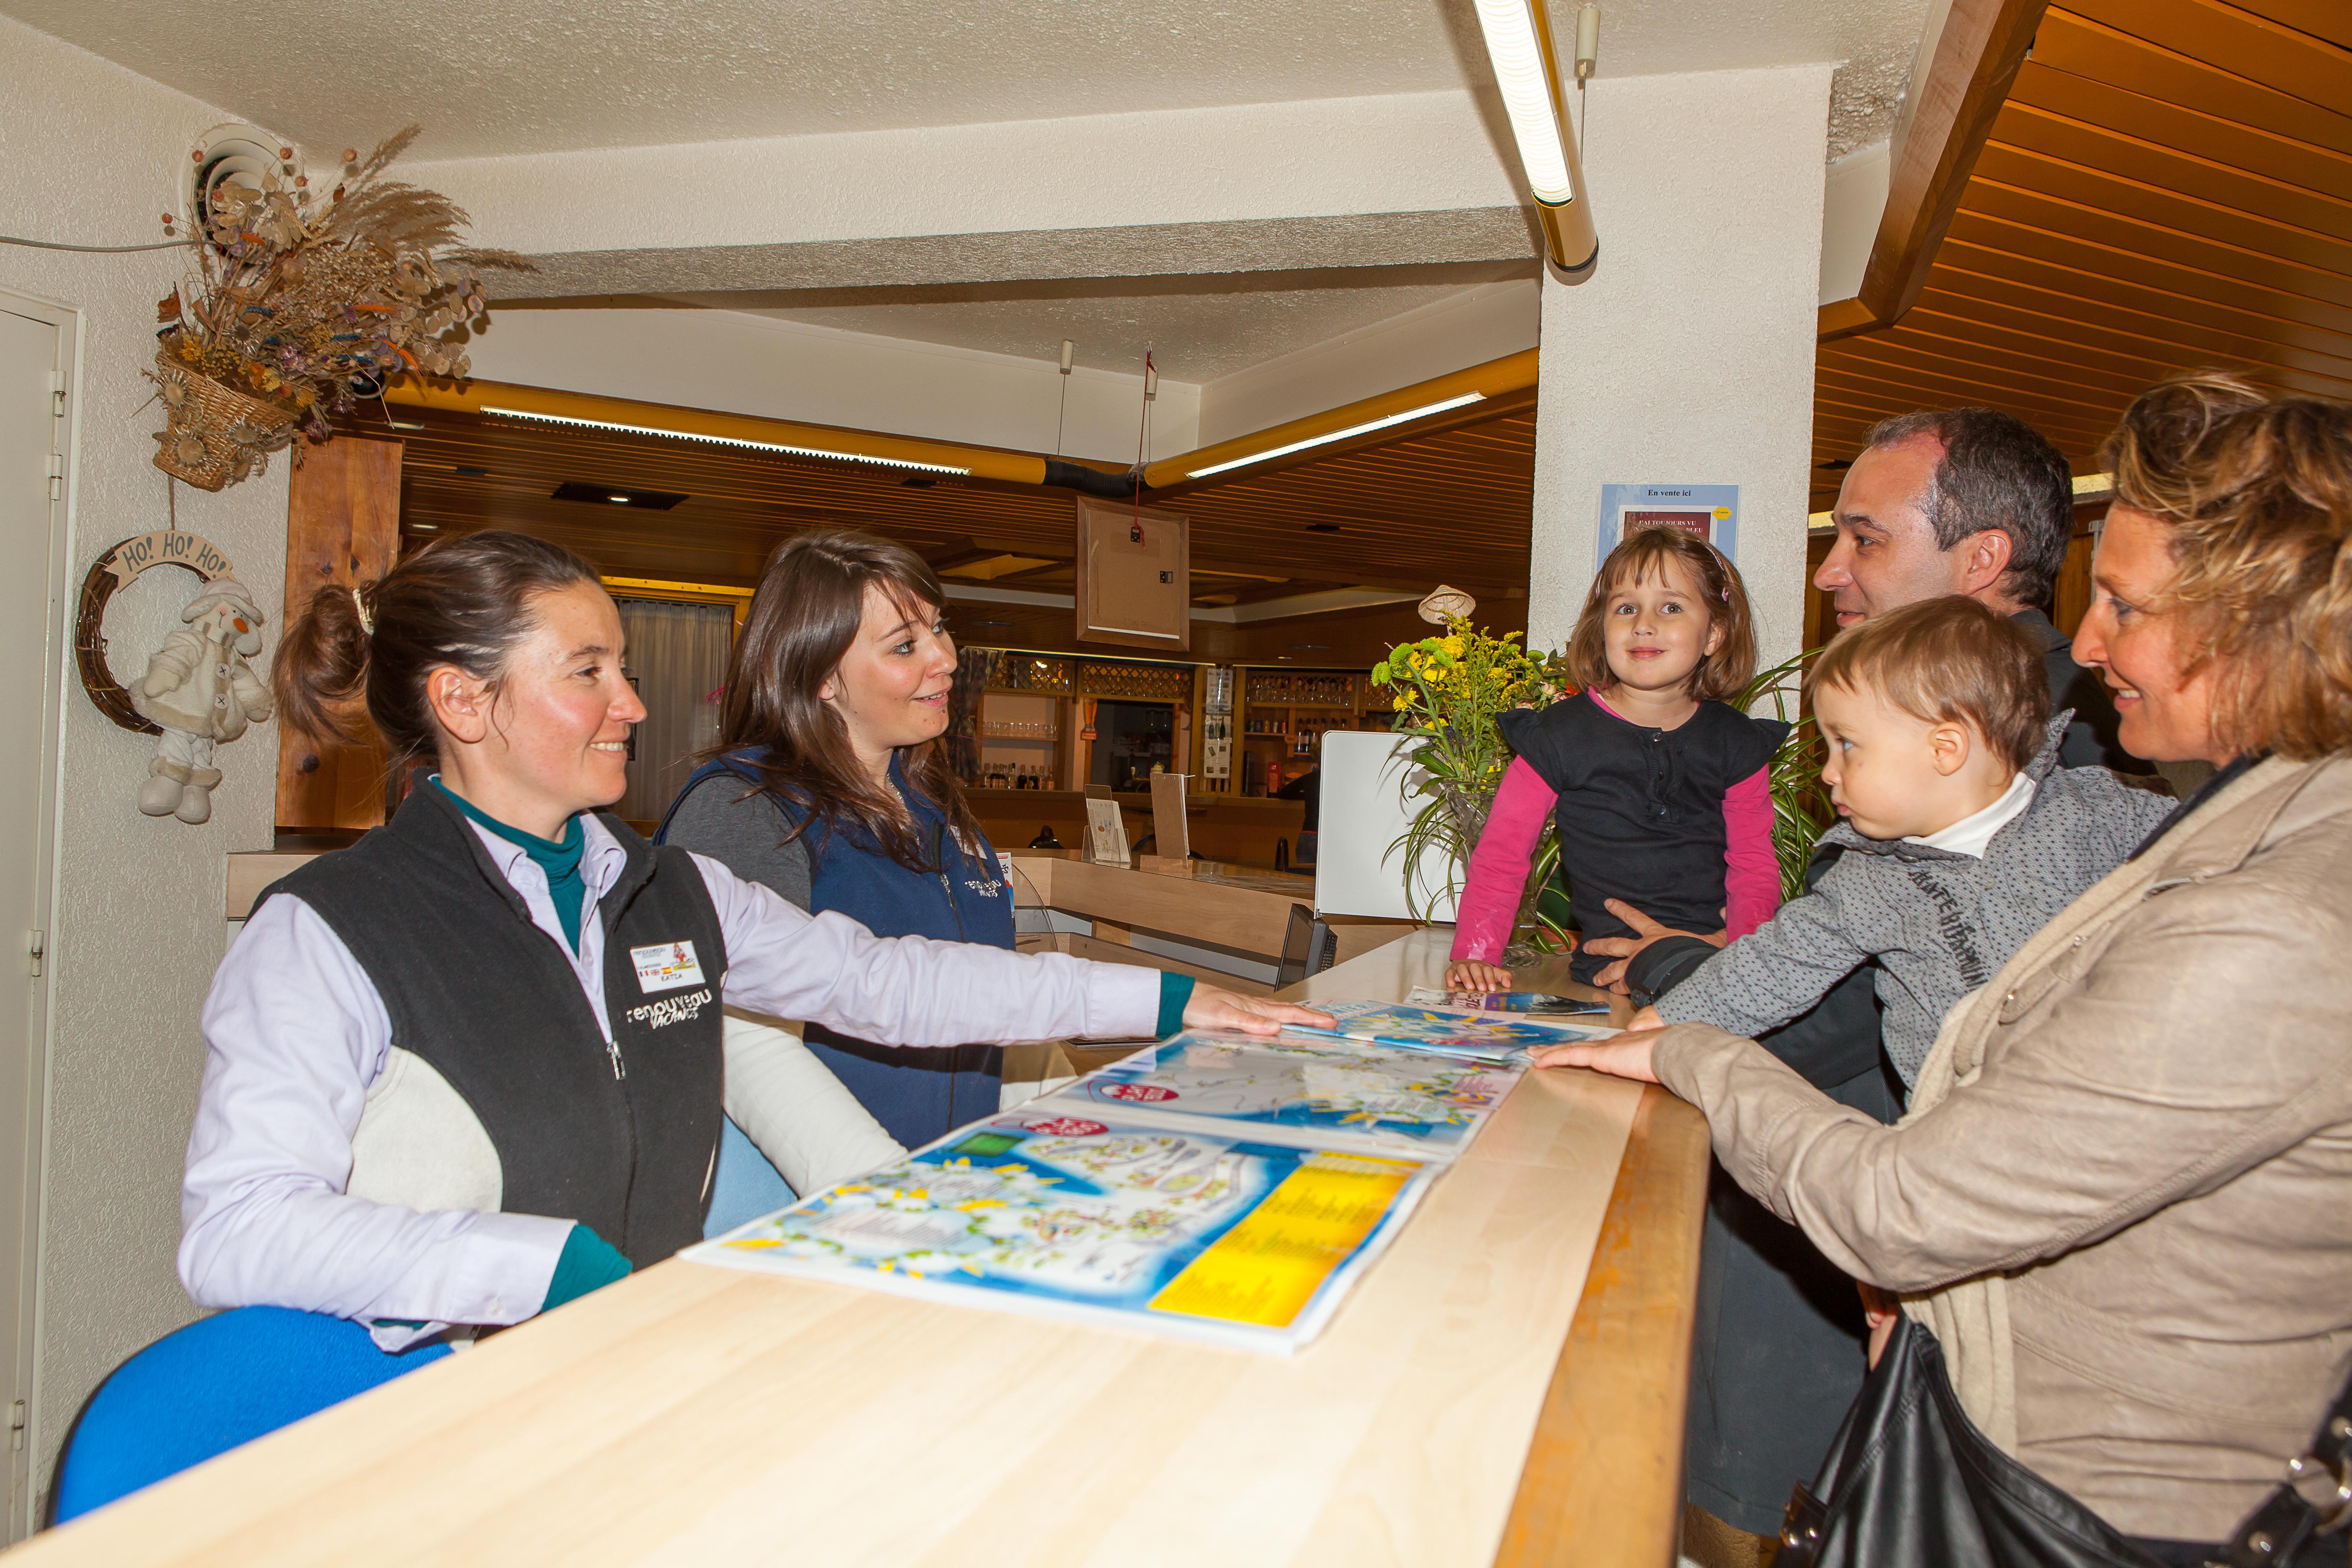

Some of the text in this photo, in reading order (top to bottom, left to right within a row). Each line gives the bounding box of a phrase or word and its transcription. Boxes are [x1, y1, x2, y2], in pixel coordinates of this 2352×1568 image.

[123, 533, 227, 579] HO! HO! HO!
[627, 989, 711, 1023] renouveau
